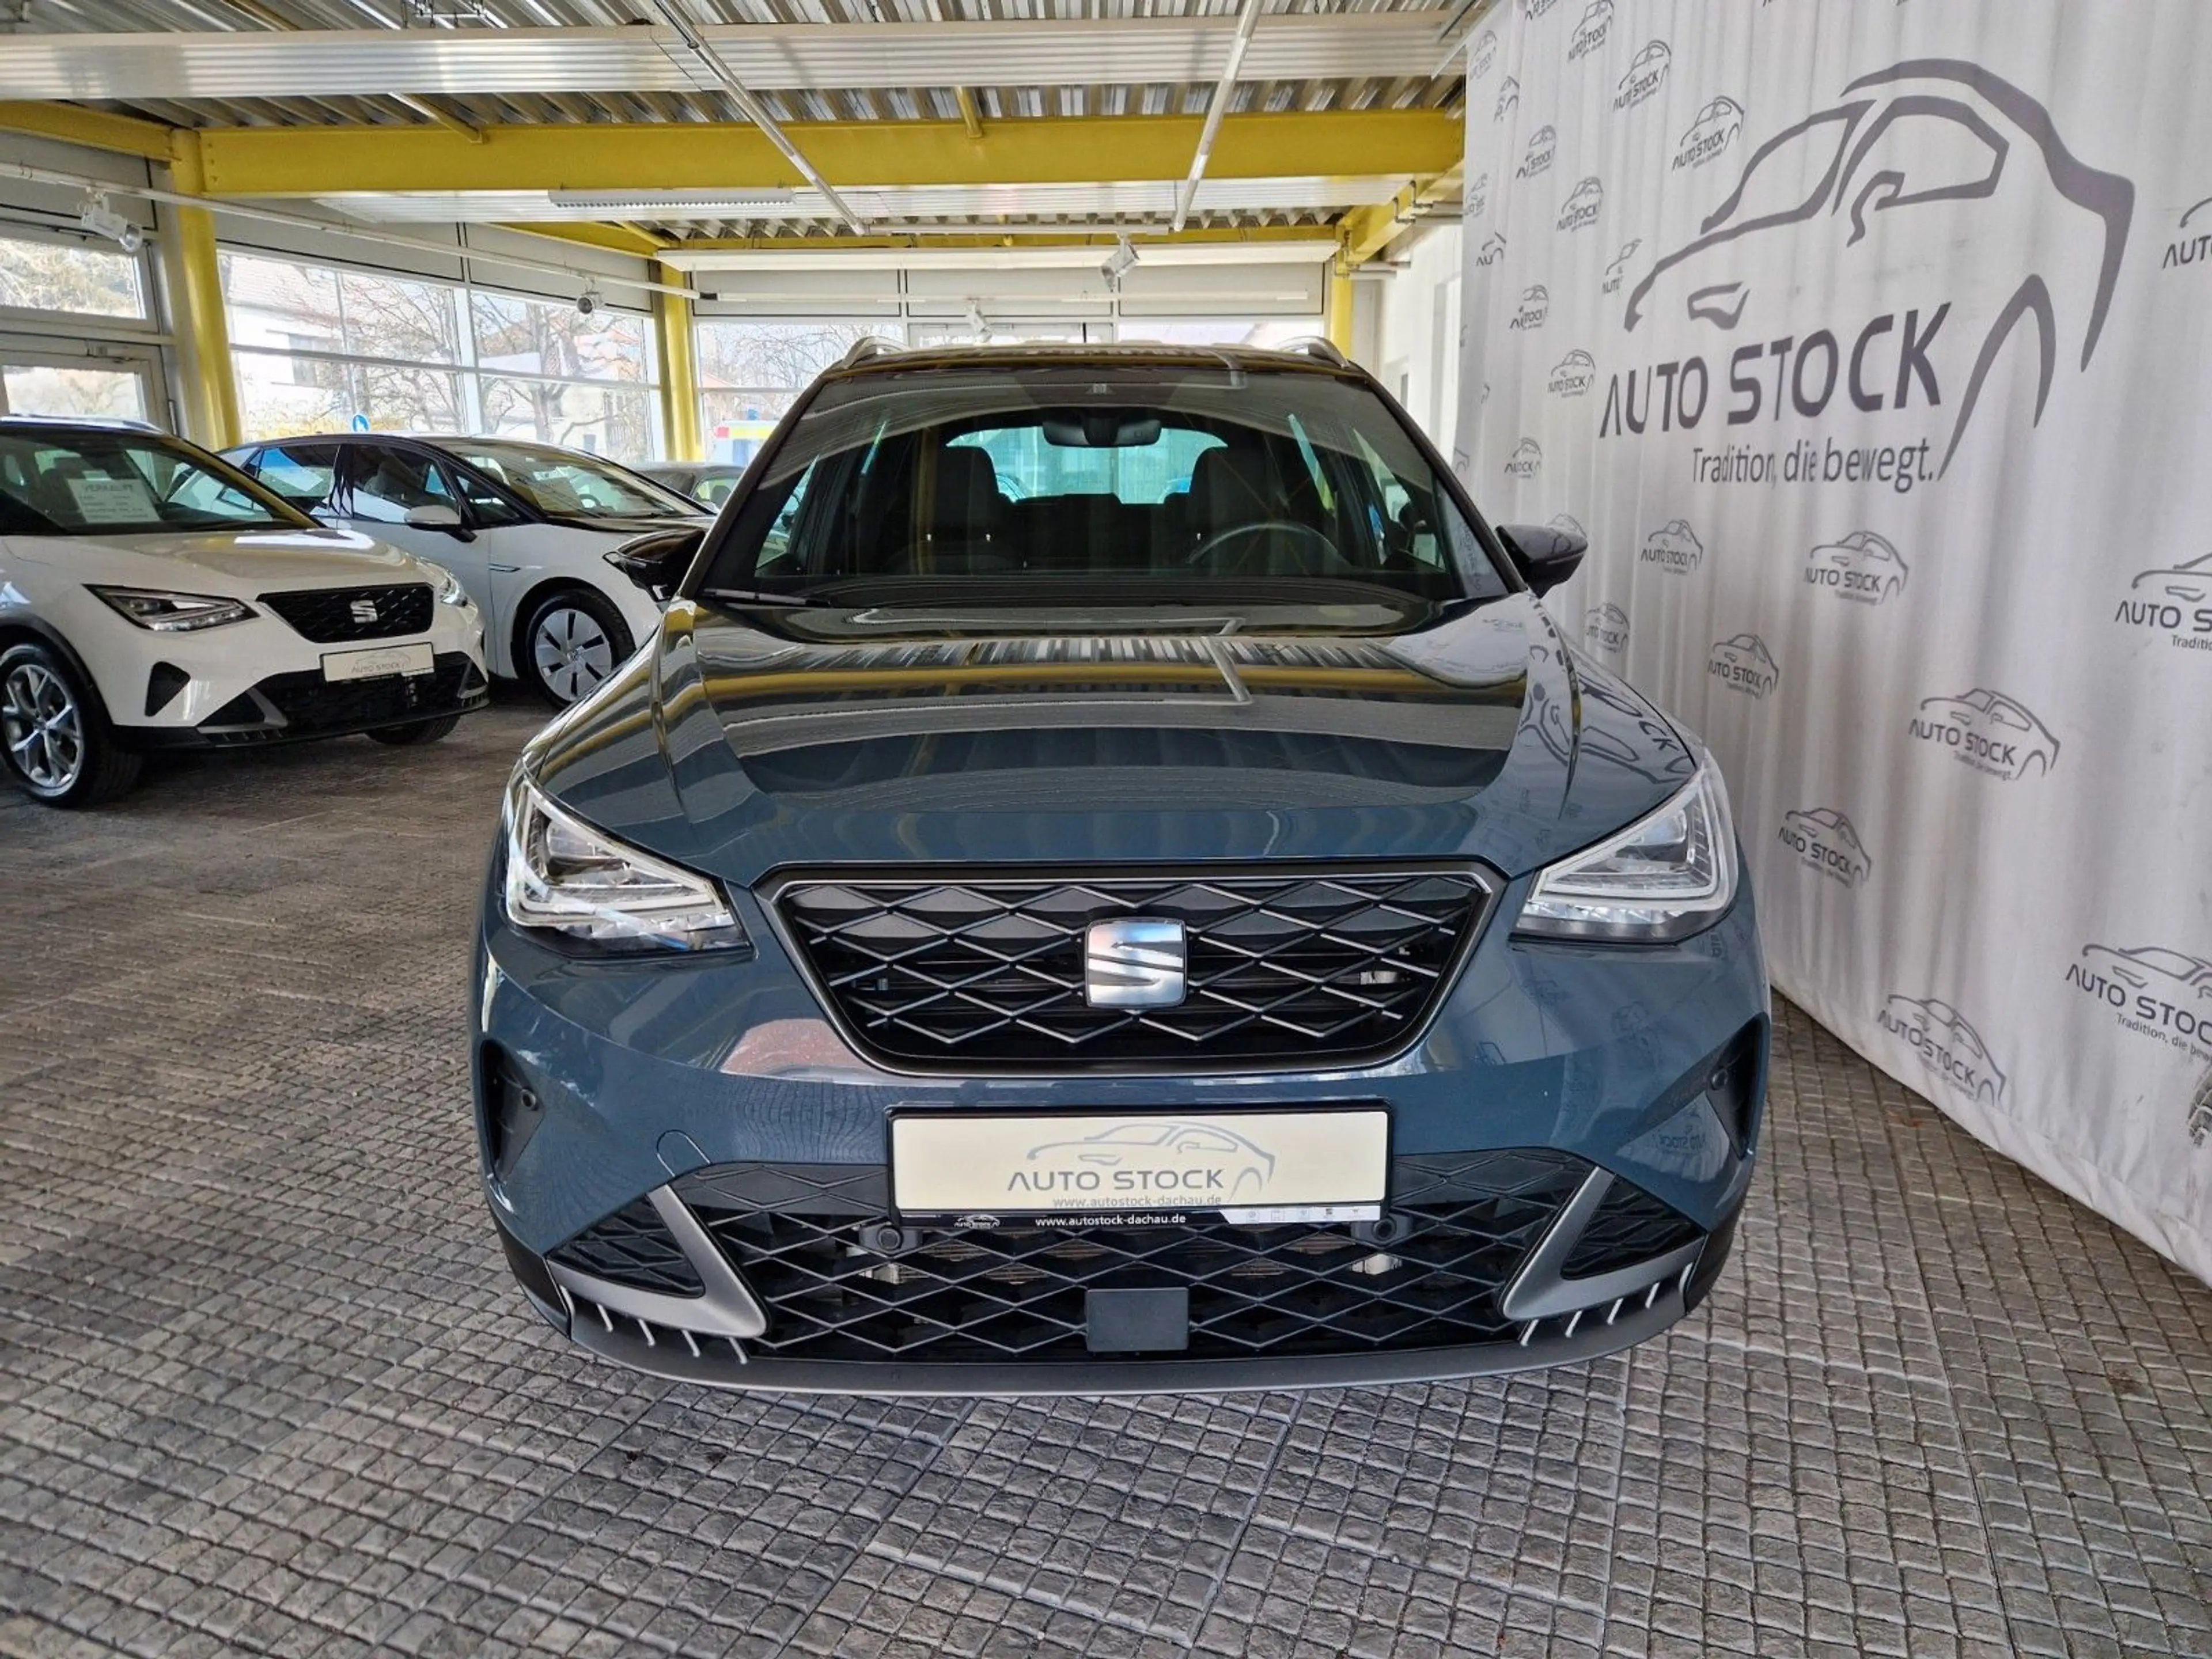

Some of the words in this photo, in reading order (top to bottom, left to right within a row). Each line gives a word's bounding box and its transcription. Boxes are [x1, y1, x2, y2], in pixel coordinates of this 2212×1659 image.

[2162, 234, 2212, 269] AUT
[1599, 355, 1709, 438] AUTO
[1727, 301, 1952, 426] STOCK
[1783, 439, 1816, 483] die
[1823, 437, 1933, 494] bewegt.
[2115, 600, 2181, 629] AUTO
[2192, 608, 2212, 632] S
[1908, 718, 1961, 746] AUTO
[1964, 732, 2017, 767] STOCK
[1778, 826, 1806, 853] AUTO
[2065, 963, 2126, 1007] AUTO
[2135, 995, 2212, 1046] STOC
[2115, 1012, 2169, 1044] Tradition,
[1877, 1009, 1923, 1047] AUTO
[1923, 1037, 1976, 1089] STOCK
[1007, 1171, 1101, 1192] AUTO
[1113, 1168, 1224, 1191] STOCK
[1052, 1194, 1222, 1209] www.autostock-dachau.de
[1035, 1213, 1187, 1228] www.autostock-dachau.de
